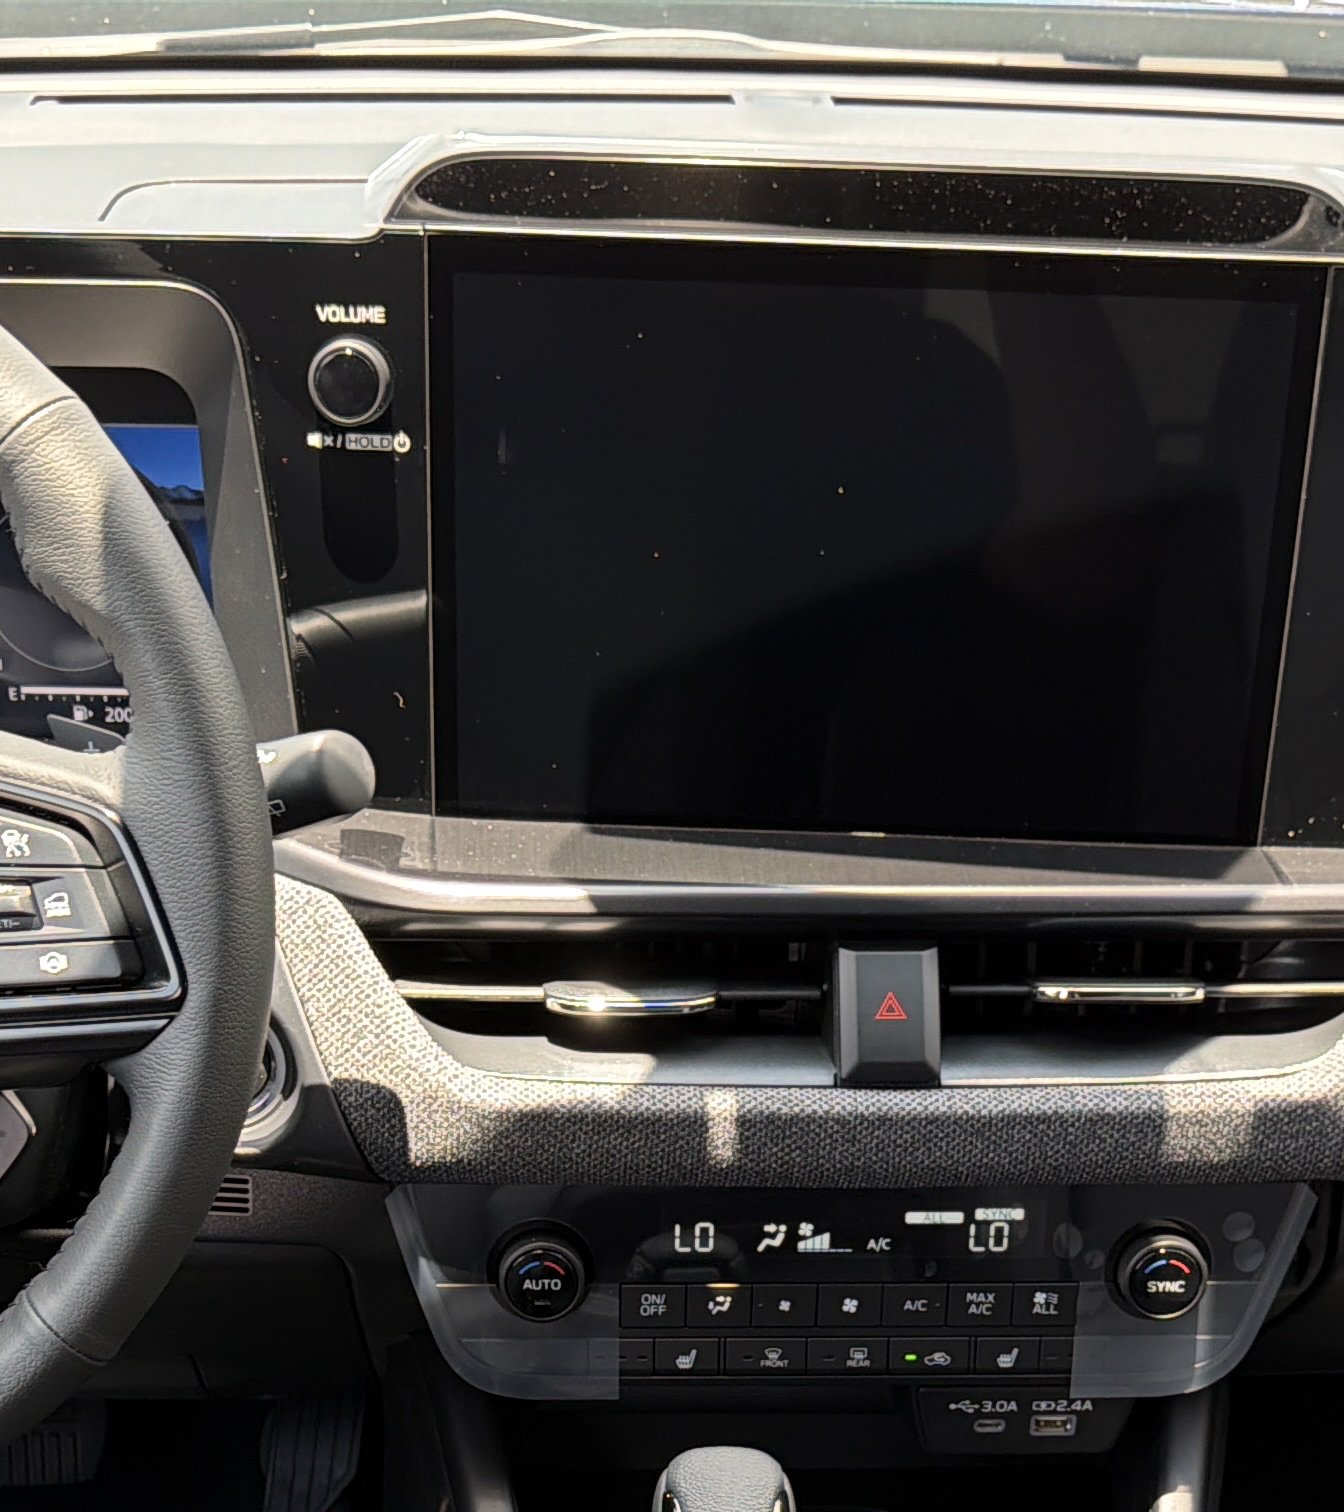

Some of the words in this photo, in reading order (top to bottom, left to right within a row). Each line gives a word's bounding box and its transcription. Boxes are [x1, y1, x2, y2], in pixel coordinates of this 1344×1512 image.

[315, 304, 387, 325] VOLUME
[348, 436, 391, 449] HOLD
[8, 687, 18, 701] E
[674, 1222, 715, 1253] LO
[969, 1222, 1010, 1252] LO
[866, 1236, 892, 1252] A/C
[523, 1278, 562, 1292] AUTO
[1146, 1281, 1186, 1293] SYNC
[640, 1293, 666, 1306] ON/
[966, 1292, 996, 1304] MAX
[639, 1304, 667, 1317] OFF
[903, 1299, 928, 1312] A/C
[967, 1303, 993, 1316] A/C
[1032, 1303, 1058, 1316] ALL
[760, 1358, 788, 1368] FRONT
[846, 1358, 870, 1368] REAR
[980, 1400, 1017, 1413] 3.0A
[1056, 1400, 1093, 1412] 2.4A
